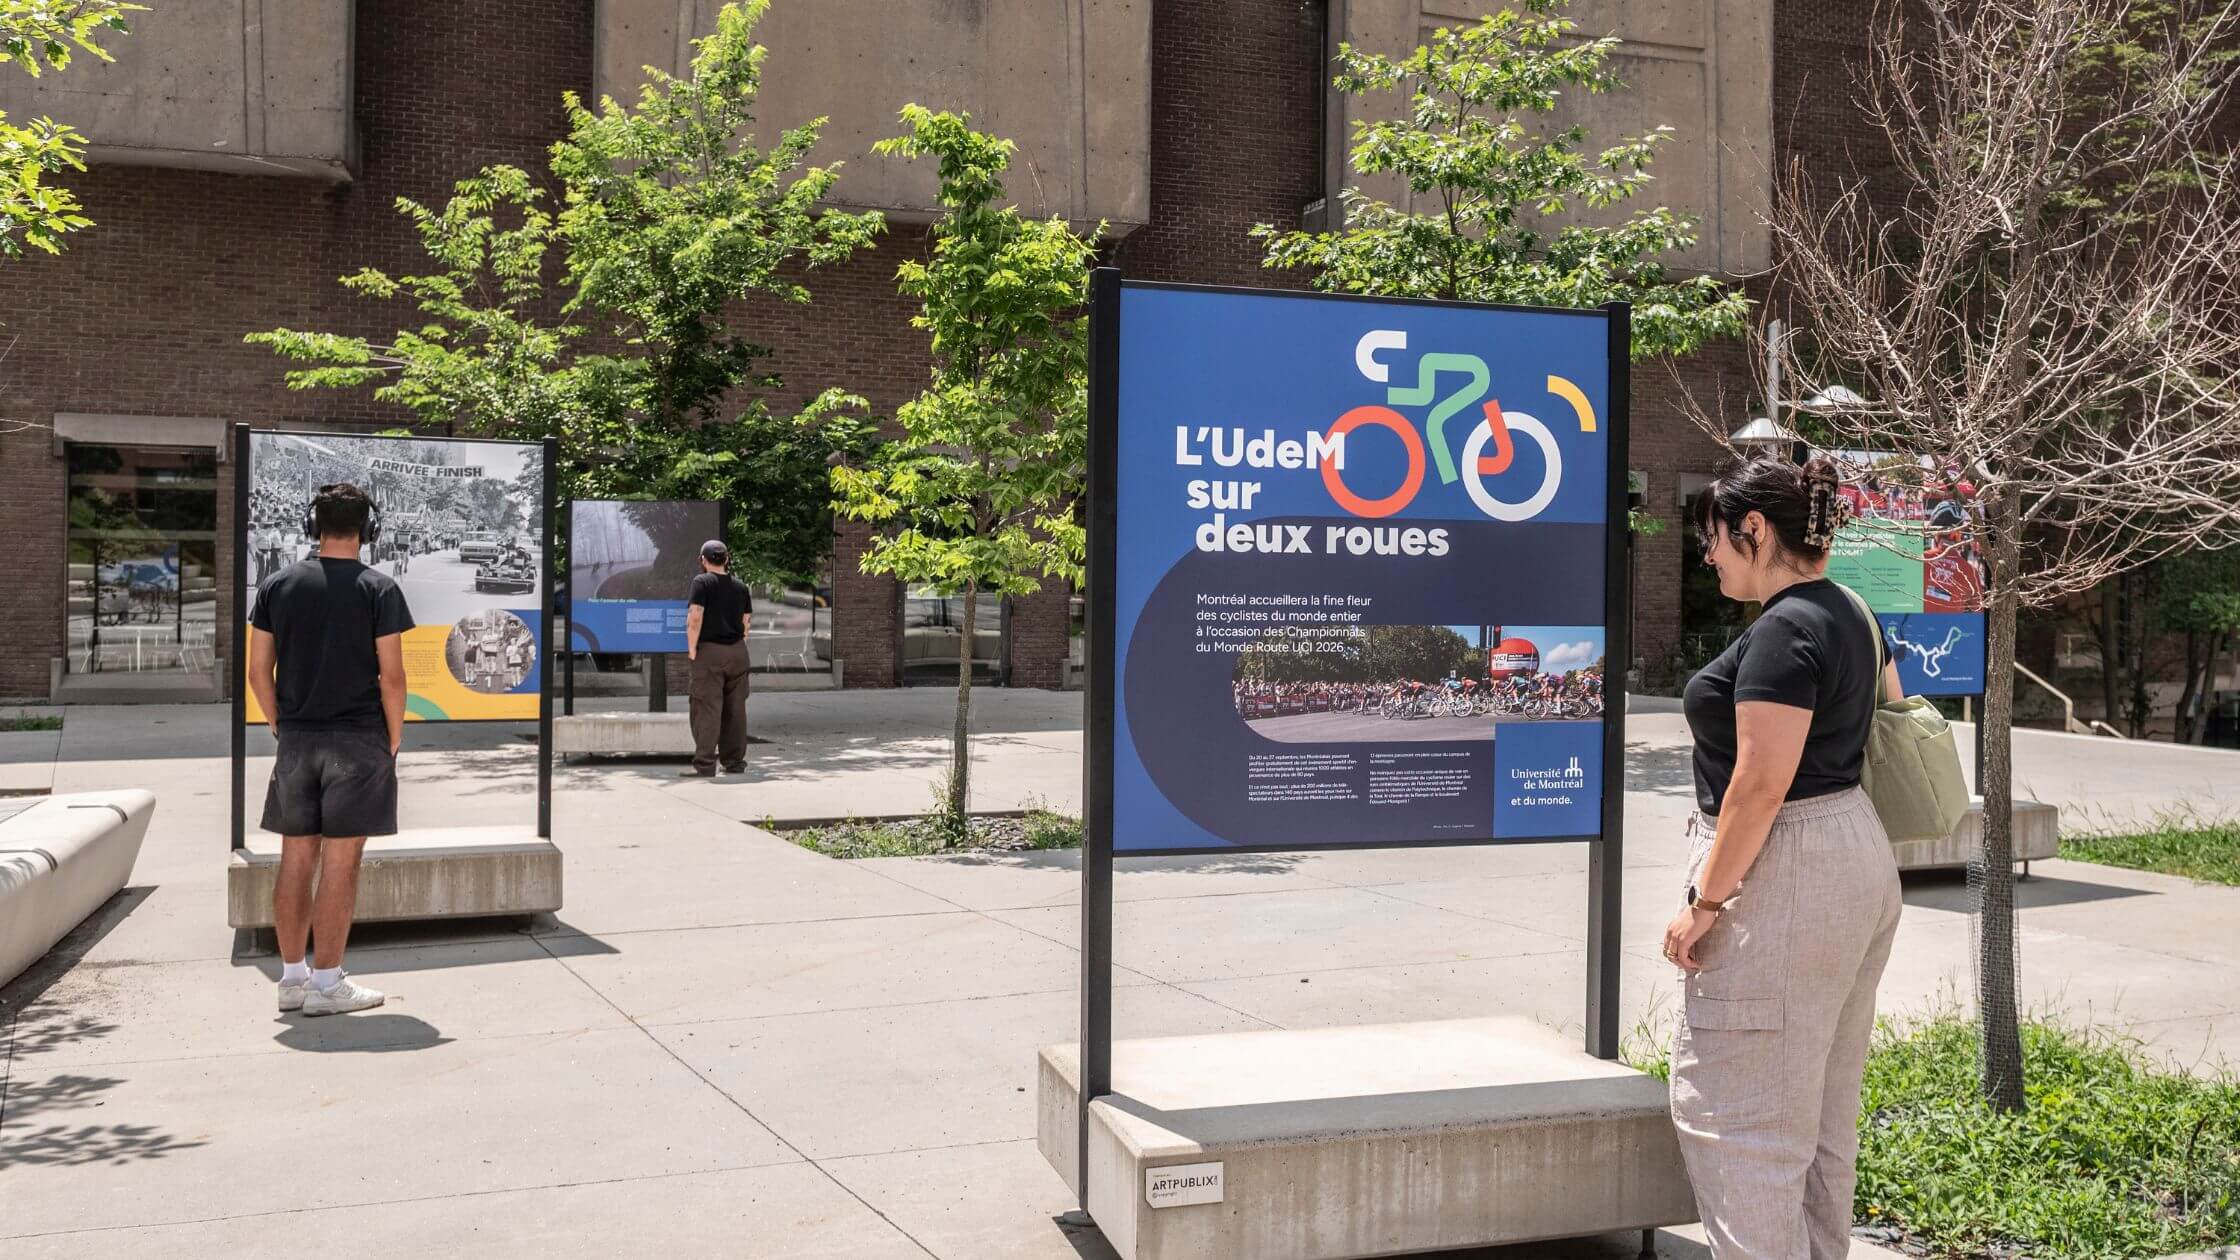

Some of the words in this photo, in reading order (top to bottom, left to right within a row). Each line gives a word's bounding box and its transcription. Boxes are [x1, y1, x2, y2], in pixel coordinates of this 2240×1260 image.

[1176, 425, 1345, 471] L'UdeM
[370, 459, 429, 477] ARRIVEE
[436, 467, 483, 478] FINISH
[1186, 479, 1261, 510] sur
[1195, 513, 1313, 553] deux
[1326, 526, 1450, 556] roues
[1197, 594, 1246, 605] Montréal
[1249, 595, 1308, 606] accueillera
[1311, 595, 1320, 605] la
[1323, 595, 1344, 606] fine
[1347, 595, 1372, 606] fleur
[1196, 610, 1217, 621] des
[1220, 610, 1268, 623] cyclistes
[1271, 610, 1285, 621] du
[1289, 611, 1327, 621] monde
[1330, 611, 1362, 621] entier
[1196, 626, 1203, 637] à
[1206, 626, 1261, 637] l'occasion
[1263, 626, 1284, 637] des
[1287, 626, 1366, 639] Championnats
[1196, 642, 1210, 652] du
[1214, 642, 1253, 652] Monde
[1256, 642, 1289, 652] Route
[1292, 642, 1312, 652] UCI
[485, 676, 492, 688] 1
[1511, 768, 1561, 778] Université
[1523, 780, 1536, 789] de
[1539, 778, 1583, 789] Montréal
[1511, 797, 1521, 806] et
[1523, 796, 1536, 806] du
[1537, 795, 1573, 805] monde.
[1152, 1175, 1214, 1191] ARTPUBLIX
